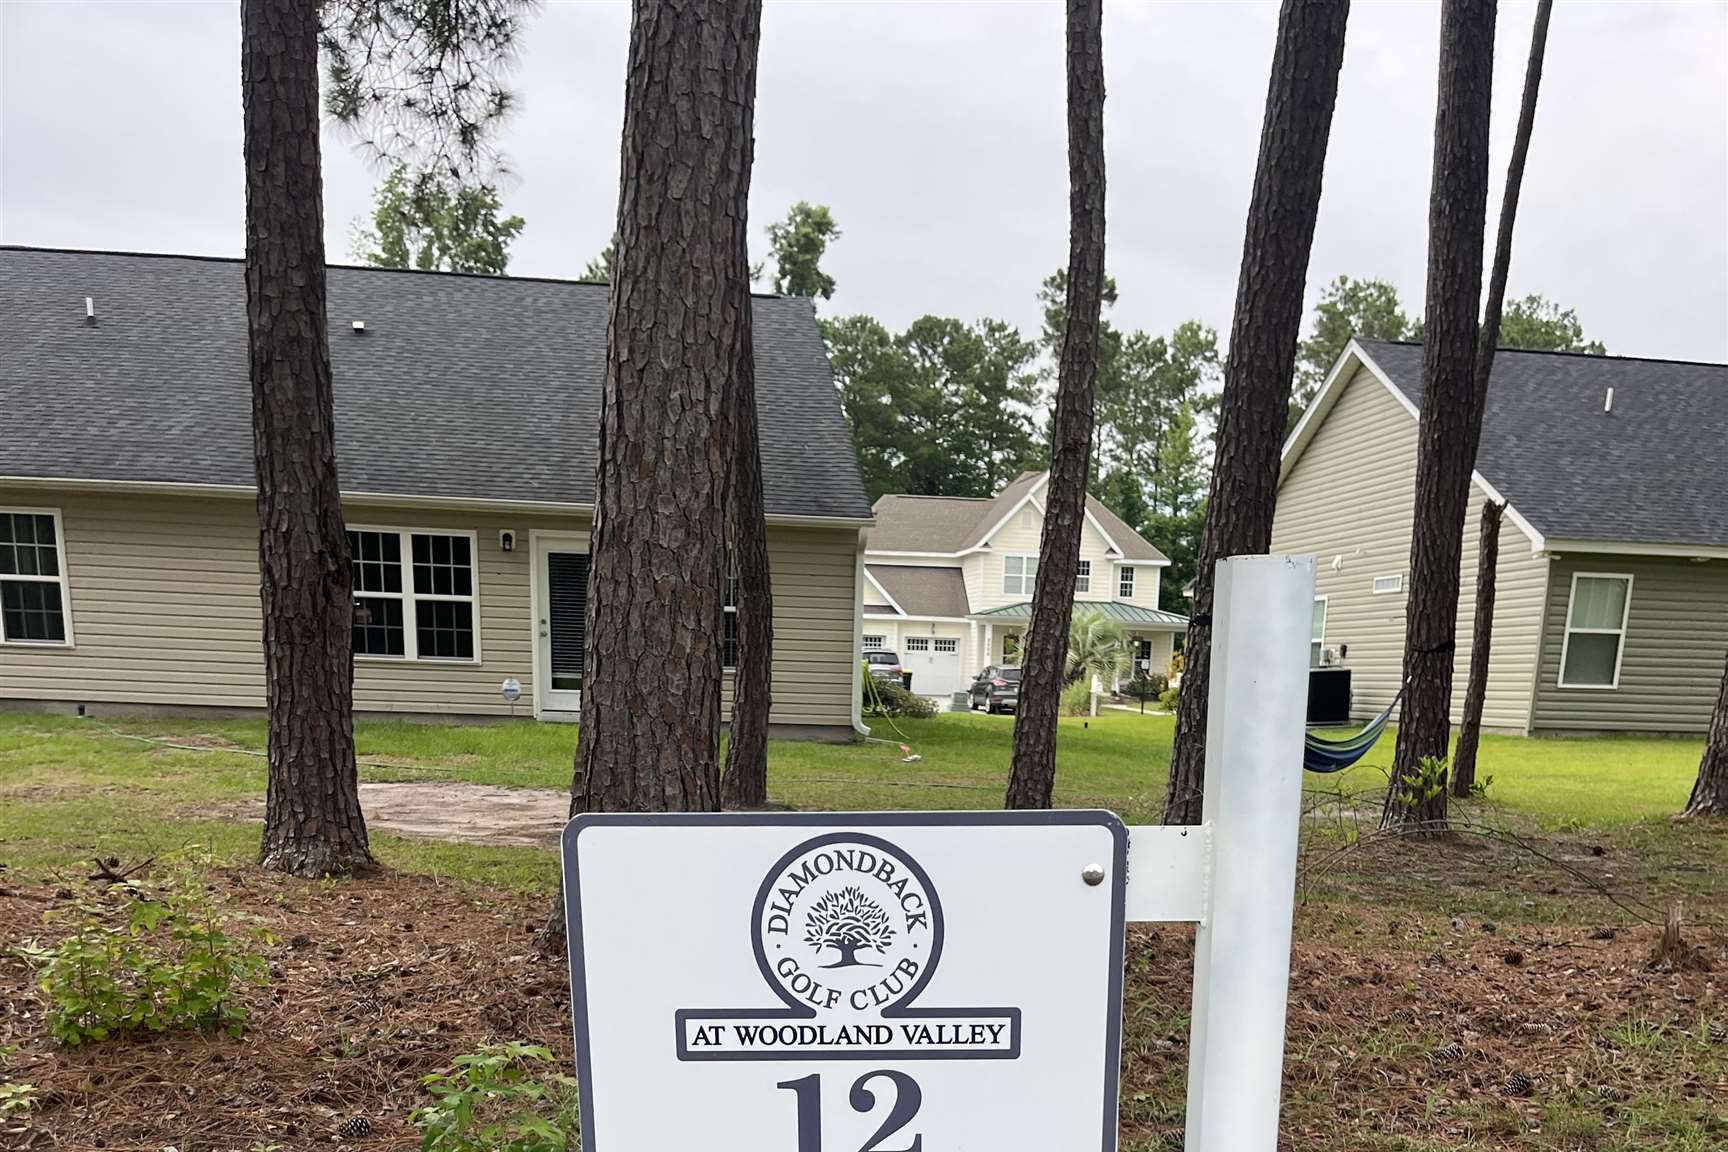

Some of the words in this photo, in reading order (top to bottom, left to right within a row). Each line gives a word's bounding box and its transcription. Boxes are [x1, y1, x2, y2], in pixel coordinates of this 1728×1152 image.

[768, 850, 927, 935] DIAMONDBACK
[777, 957, 842, 1009] GOLF
[850, 957, 919, 1010] CLUB
[691, 1026, 727, 1046] AT
[734, 1025, 893, 1046] WOODLAND
[900, 1024, 1007, 1046] VALLEY
